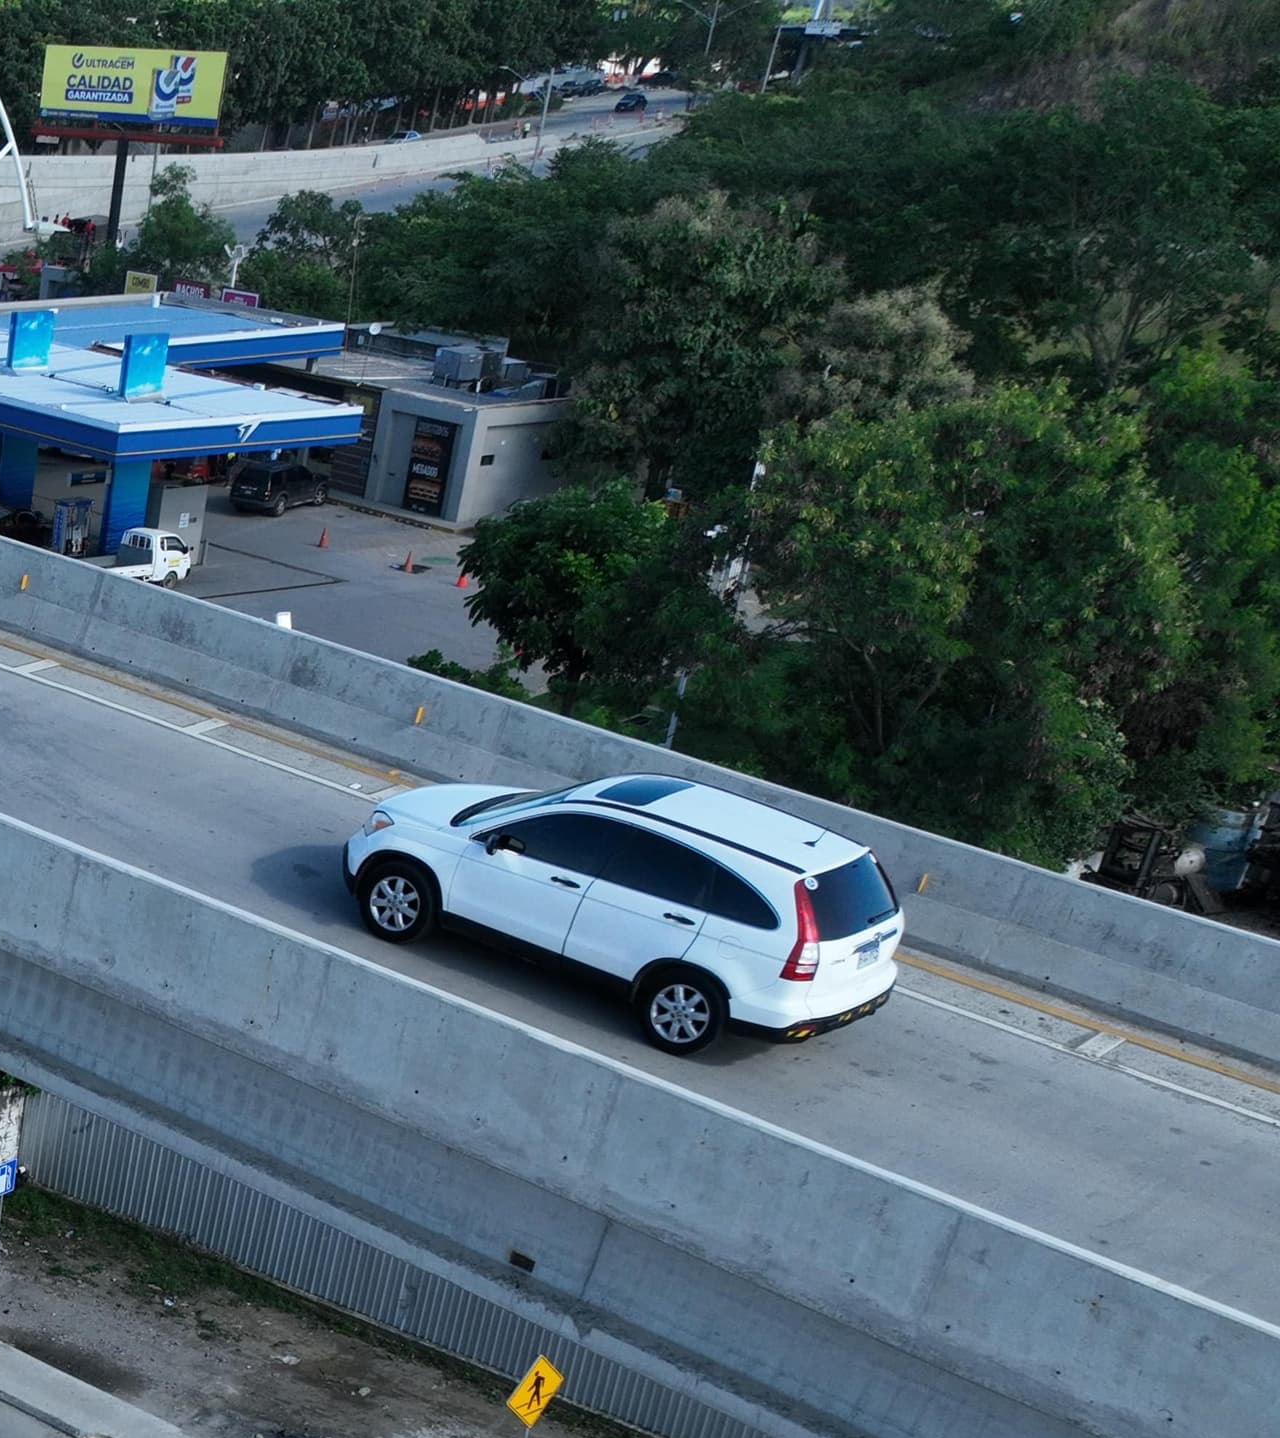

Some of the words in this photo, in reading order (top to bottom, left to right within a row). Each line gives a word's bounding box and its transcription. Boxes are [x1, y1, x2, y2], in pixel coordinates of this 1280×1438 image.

[85, 58, 135, 70] ULTRACEM
[66, 74, 134, 91] CALIDAD
[67, 90, 130, 103] GARANTIZADA
[175, 283, 205, 299] NACHOS
